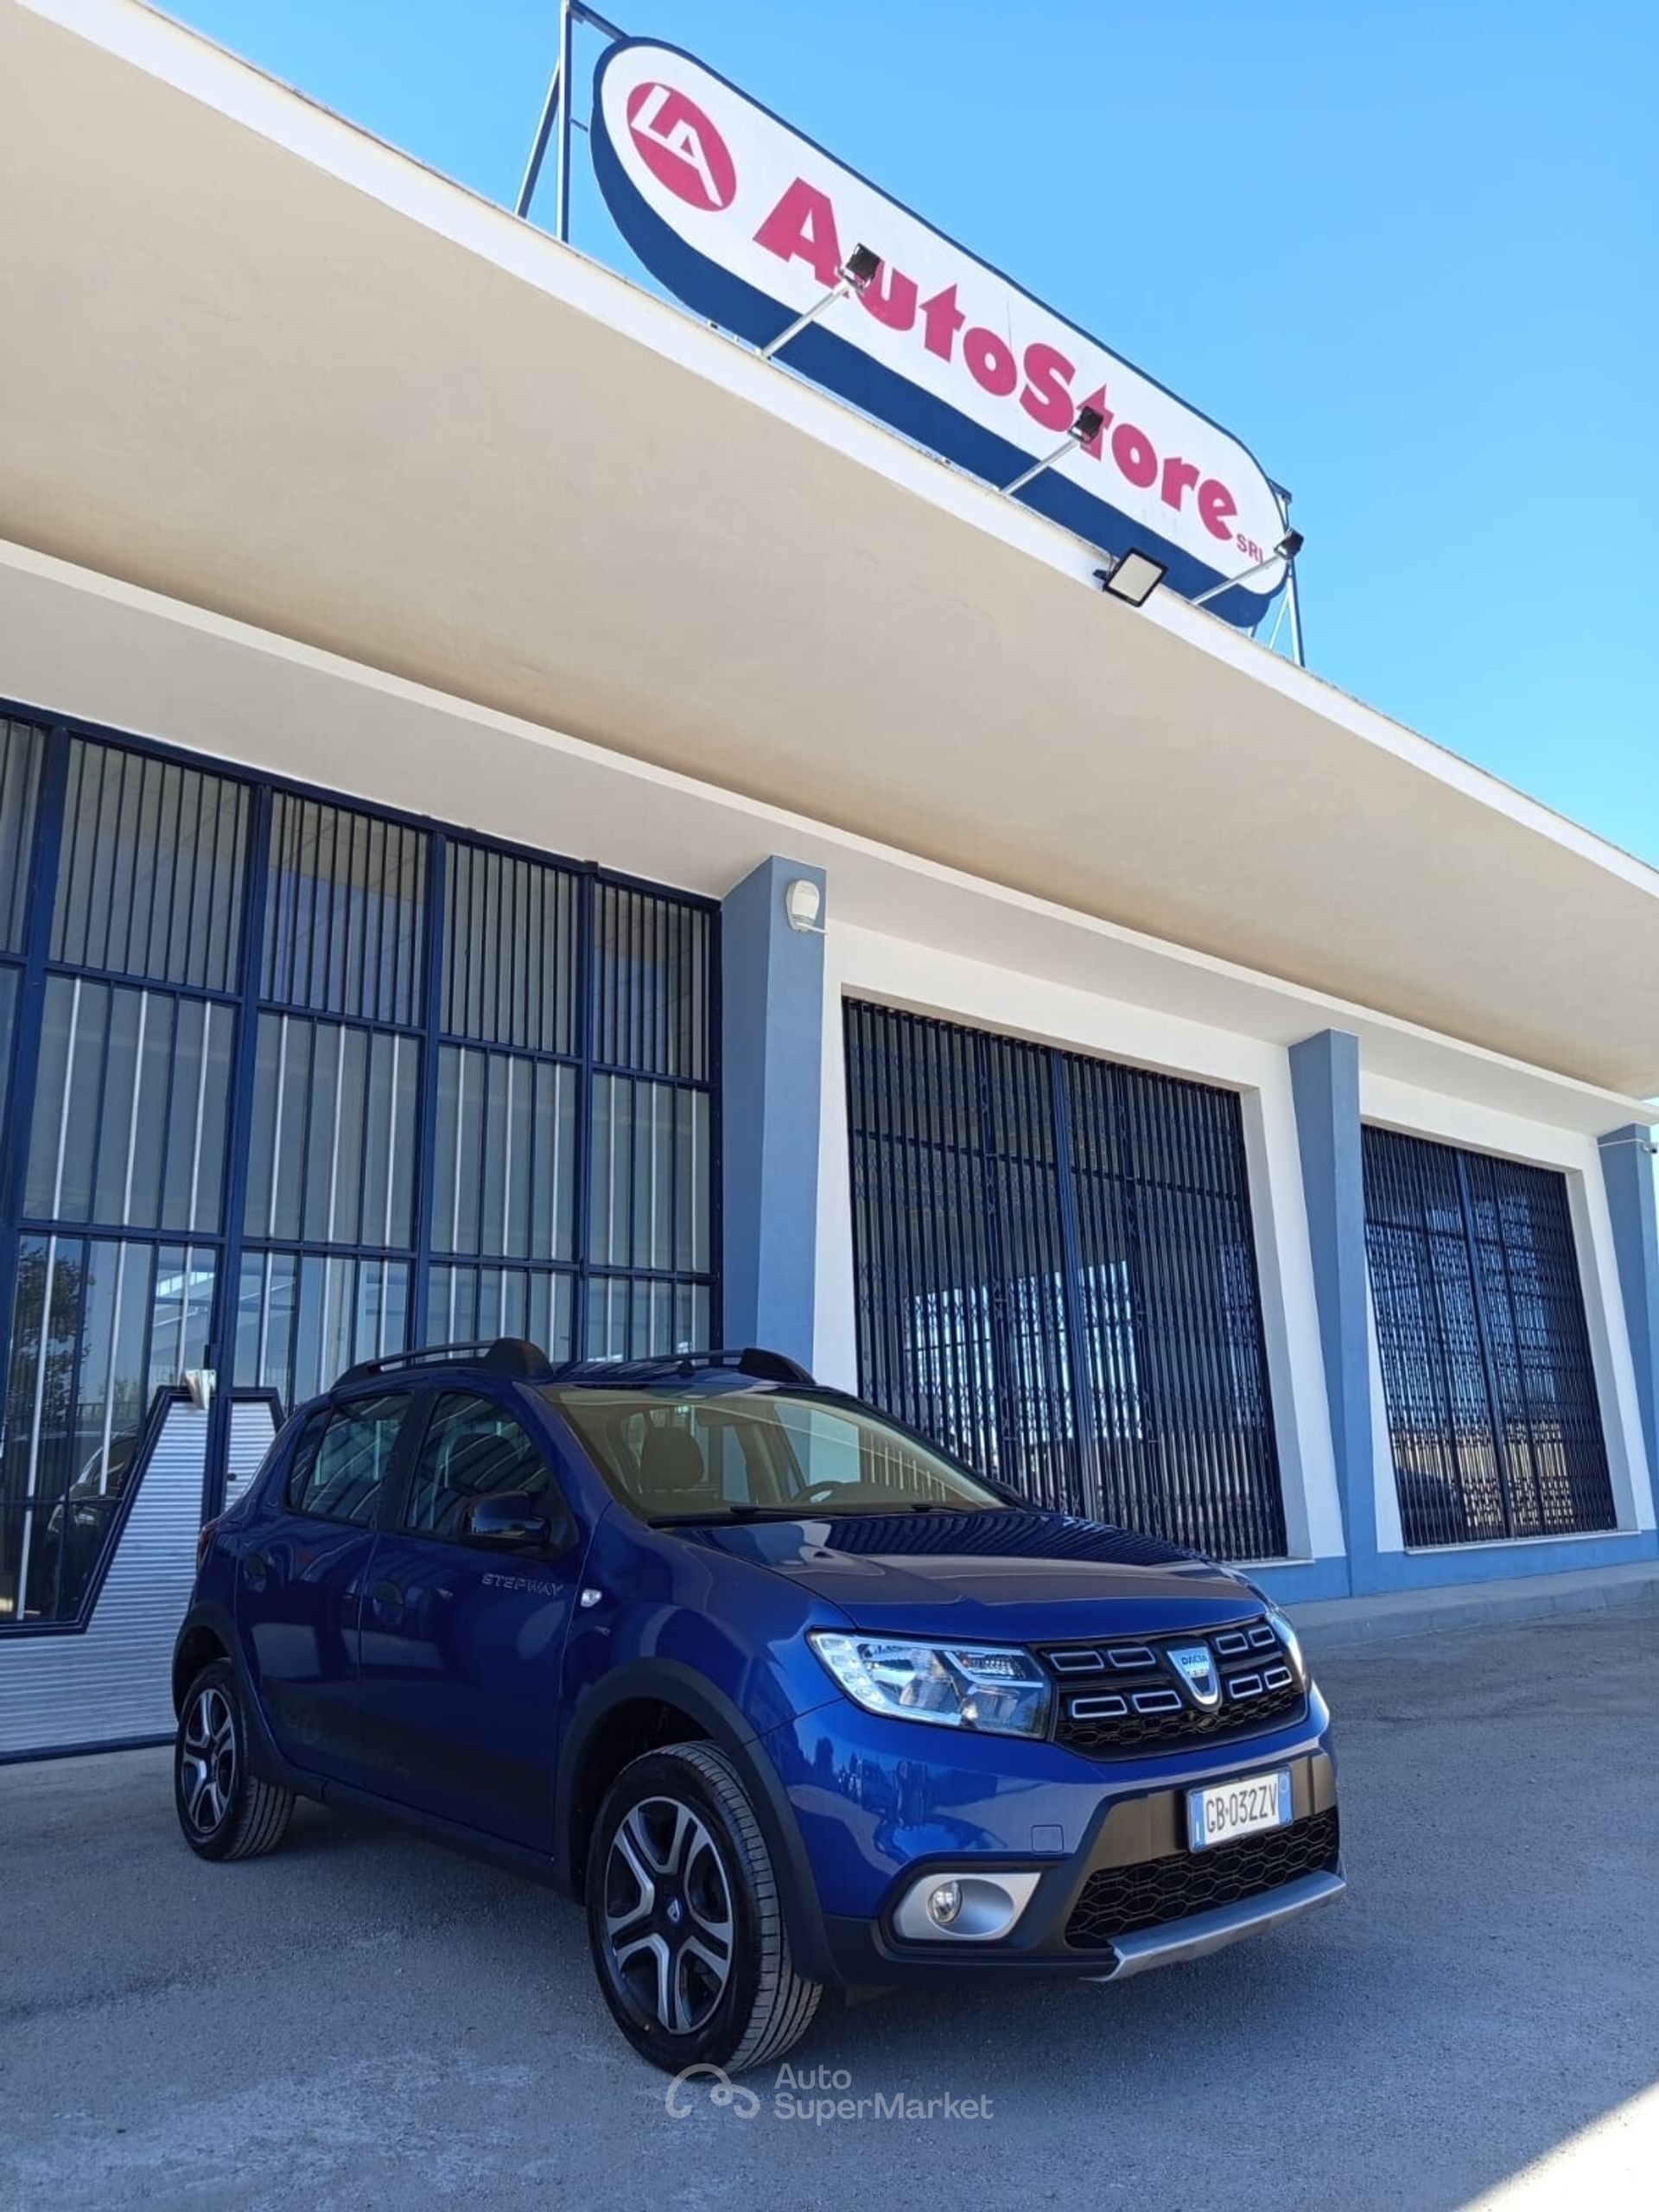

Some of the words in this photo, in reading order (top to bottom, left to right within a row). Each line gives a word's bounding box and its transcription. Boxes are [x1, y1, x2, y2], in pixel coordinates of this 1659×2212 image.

[753, 177, 1238, 541] AutoStore
[481, 1572, 564, 1596] STEPWAY
[1180, 1655, 1208, 1665] DACIA
